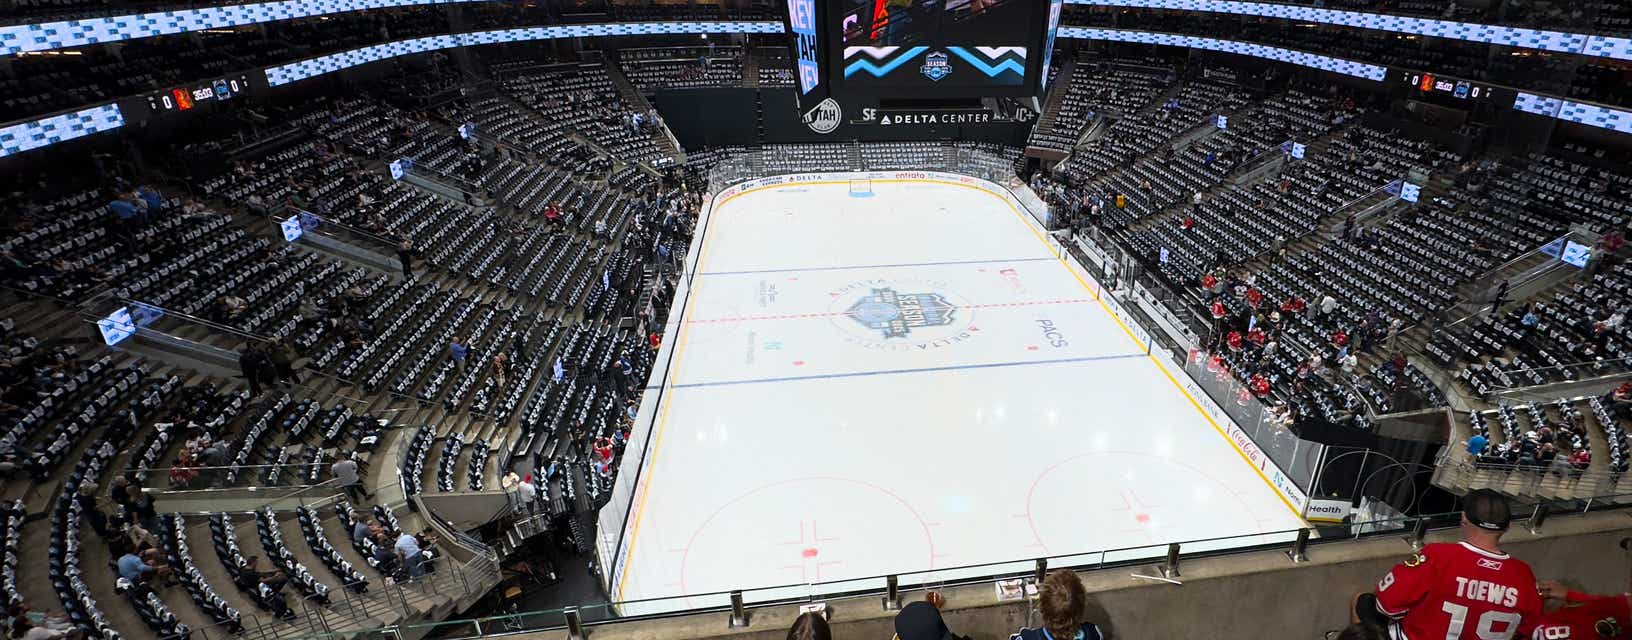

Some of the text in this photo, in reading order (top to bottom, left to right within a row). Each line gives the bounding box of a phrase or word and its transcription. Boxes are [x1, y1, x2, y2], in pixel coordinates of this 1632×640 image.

[230, 79, 239, 92] 0
[1412, 75, 1420, 86] 0
[192, 87, 214, 101] 35:03
[1471, 87, 1480, 98] 0
[162, 95, 173, 109] 0
[818, 109, 836, 121] TAH
[895, 114, 937, 124] DELTA
[941, 113, 989, 124] CENTER
[895, 171, 925, 180] entrata
[897, 294, 929, 328] SEASON
[1035, 318, 1069, 349] PACS
[1308, 505, 1342, 515] Health
[1456, 576, 1518, 608] TOEWS
[1441, 600, 1522, 640] 19
